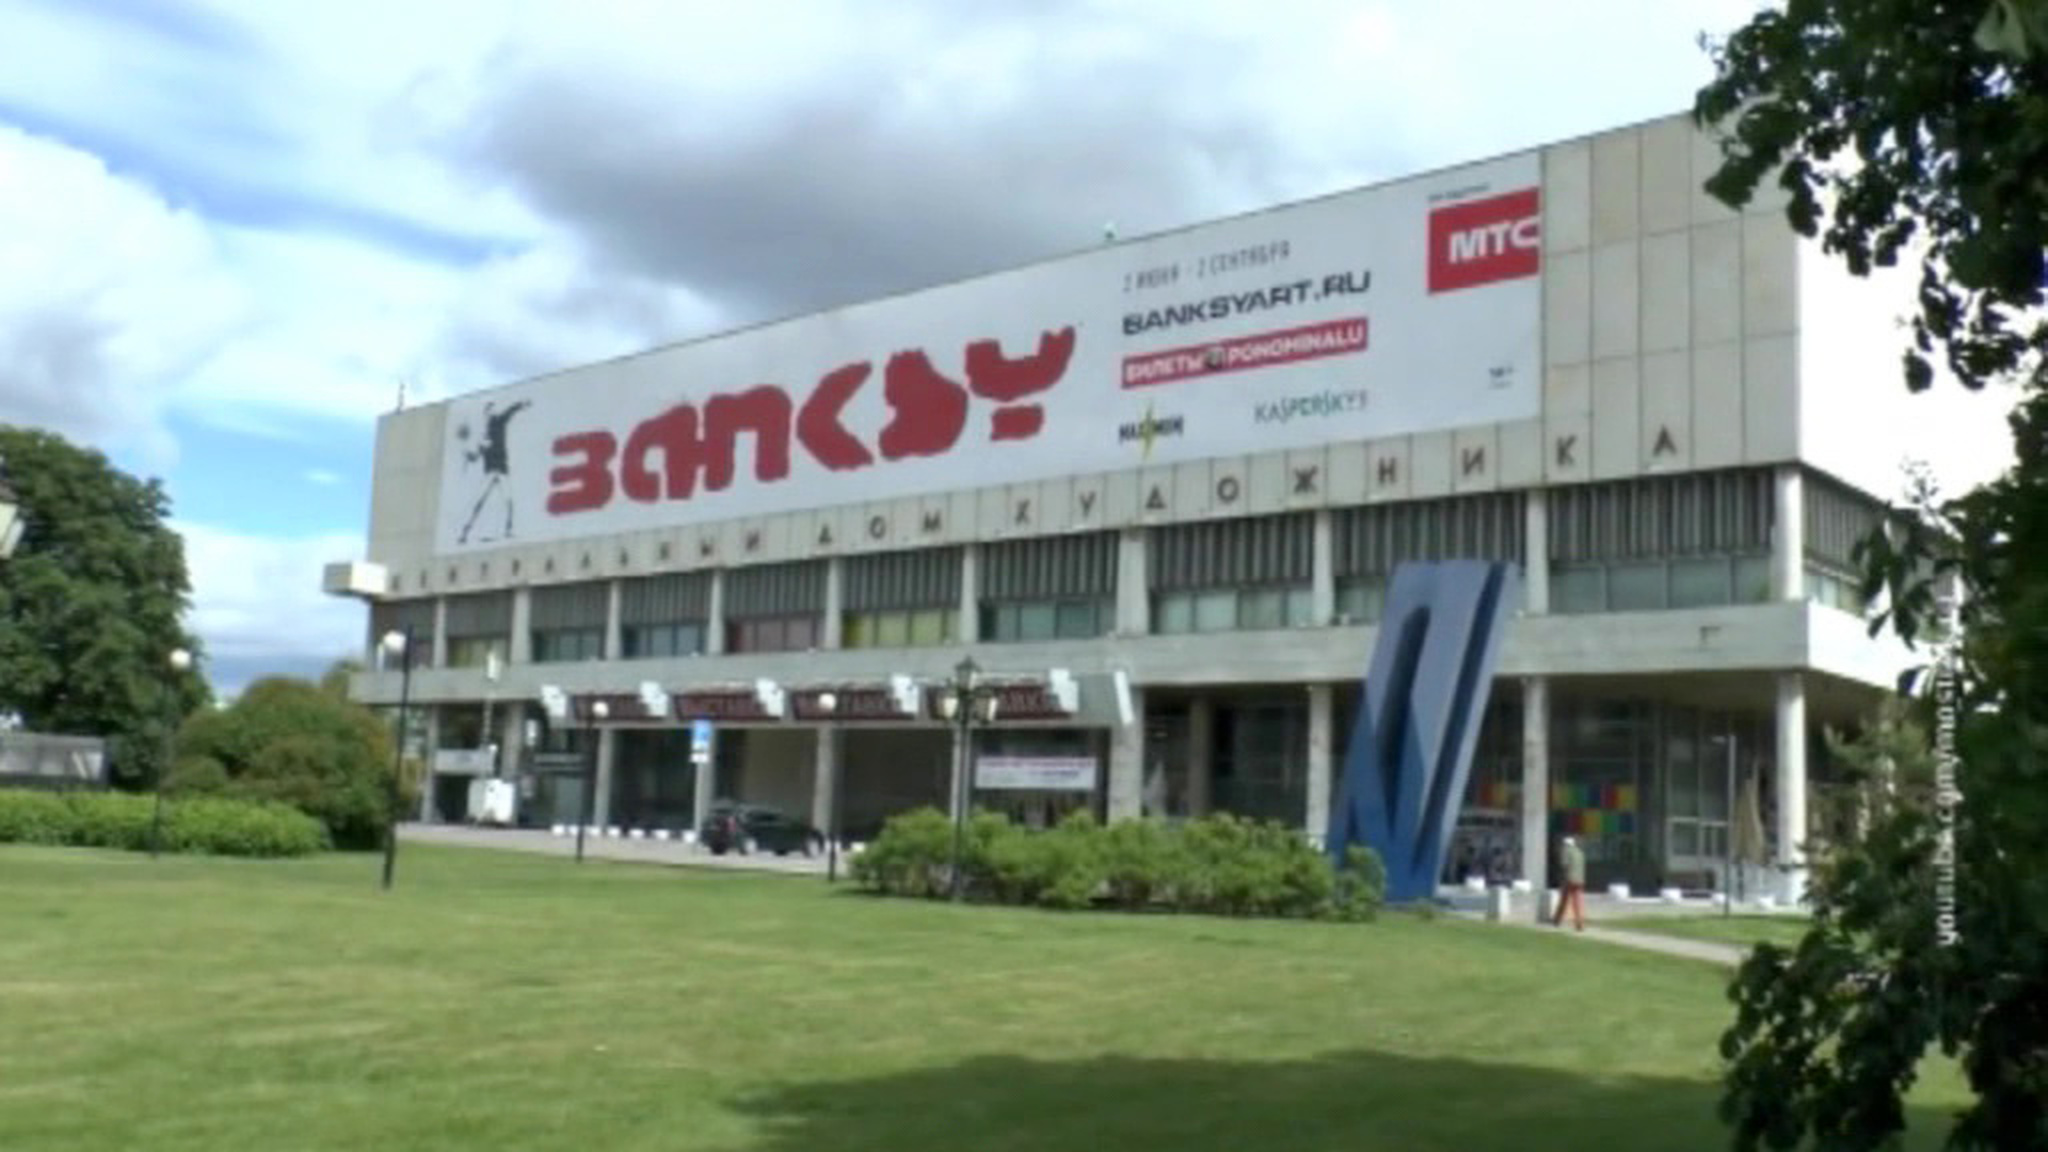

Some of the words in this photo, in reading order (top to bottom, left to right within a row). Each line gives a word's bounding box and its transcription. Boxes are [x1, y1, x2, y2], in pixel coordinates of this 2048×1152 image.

[1449, 215, 1541, 265] МТС
[1122, 271, 1372, 335] BANKSYART.RU
[1125, 353, 1204, 383] БИЛЕТЫ
[1227, 323, 1365, 365] PONOMINALU
[818, 509, 943, 545] ДОМ
[1015, 424, 1678, 526] ХУДОЖНИКА
